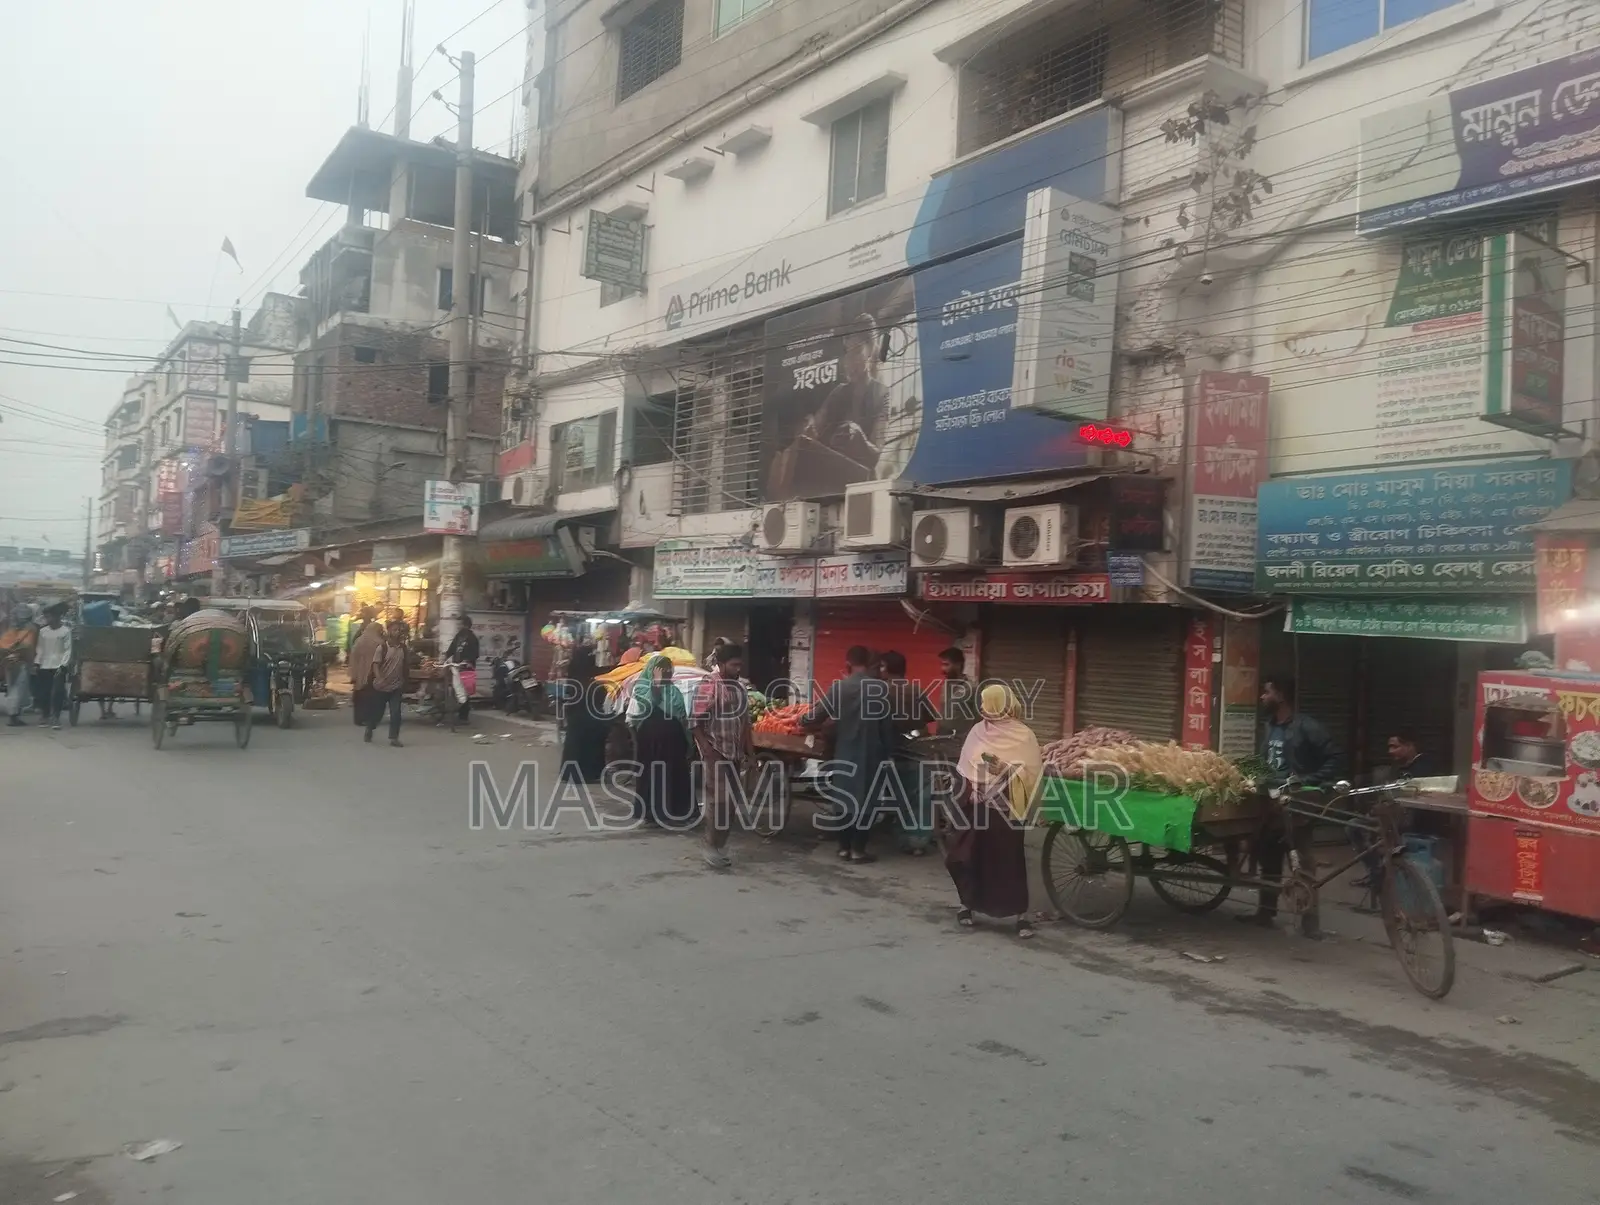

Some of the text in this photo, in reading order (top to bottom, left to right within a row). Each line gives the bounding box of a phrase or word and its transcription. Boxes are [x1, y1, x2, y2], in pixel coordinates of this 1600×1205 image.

[1460, 89, 1543, 147] মামুন
[688, 259, 793, 318] Prime Bank
[792, 358, 840, 390] সহজে
[1375, 478, 1425, 497] মাসুম
[1483, 468, 1558, 486] সরকার
[1327, 532, 1342, 542] ও
[1348, 527, 1411, 542] স্ত্রীরোগ
[1264, 560, 1306, 579] জননী
[1311, 559, 1360, 578] রিয়েল
[1366, 559, 1425, 580] হোমিও
[927, 579, 1007, 601] ইসলামিয়া
